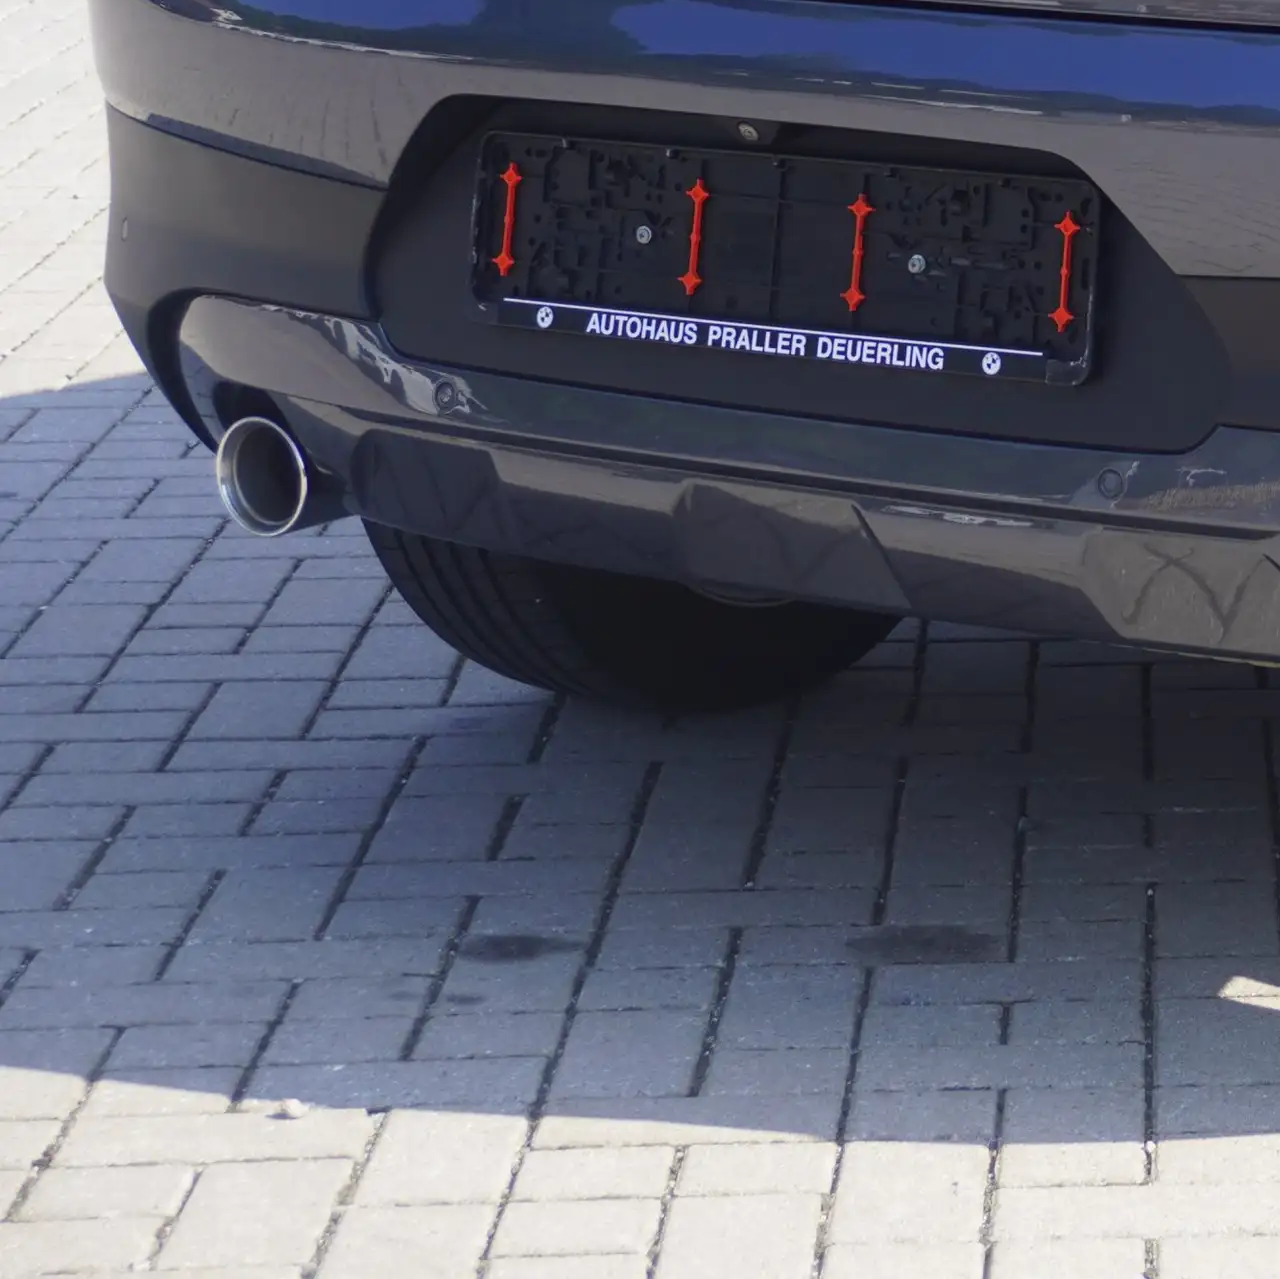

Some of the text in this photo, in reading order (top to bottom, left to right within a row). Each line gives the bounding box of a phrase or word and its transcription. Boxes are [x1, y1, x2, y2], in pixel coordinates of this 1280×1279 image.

[585, 312, 945, 370] AUTOHAUS PRALLER DEUERLING
